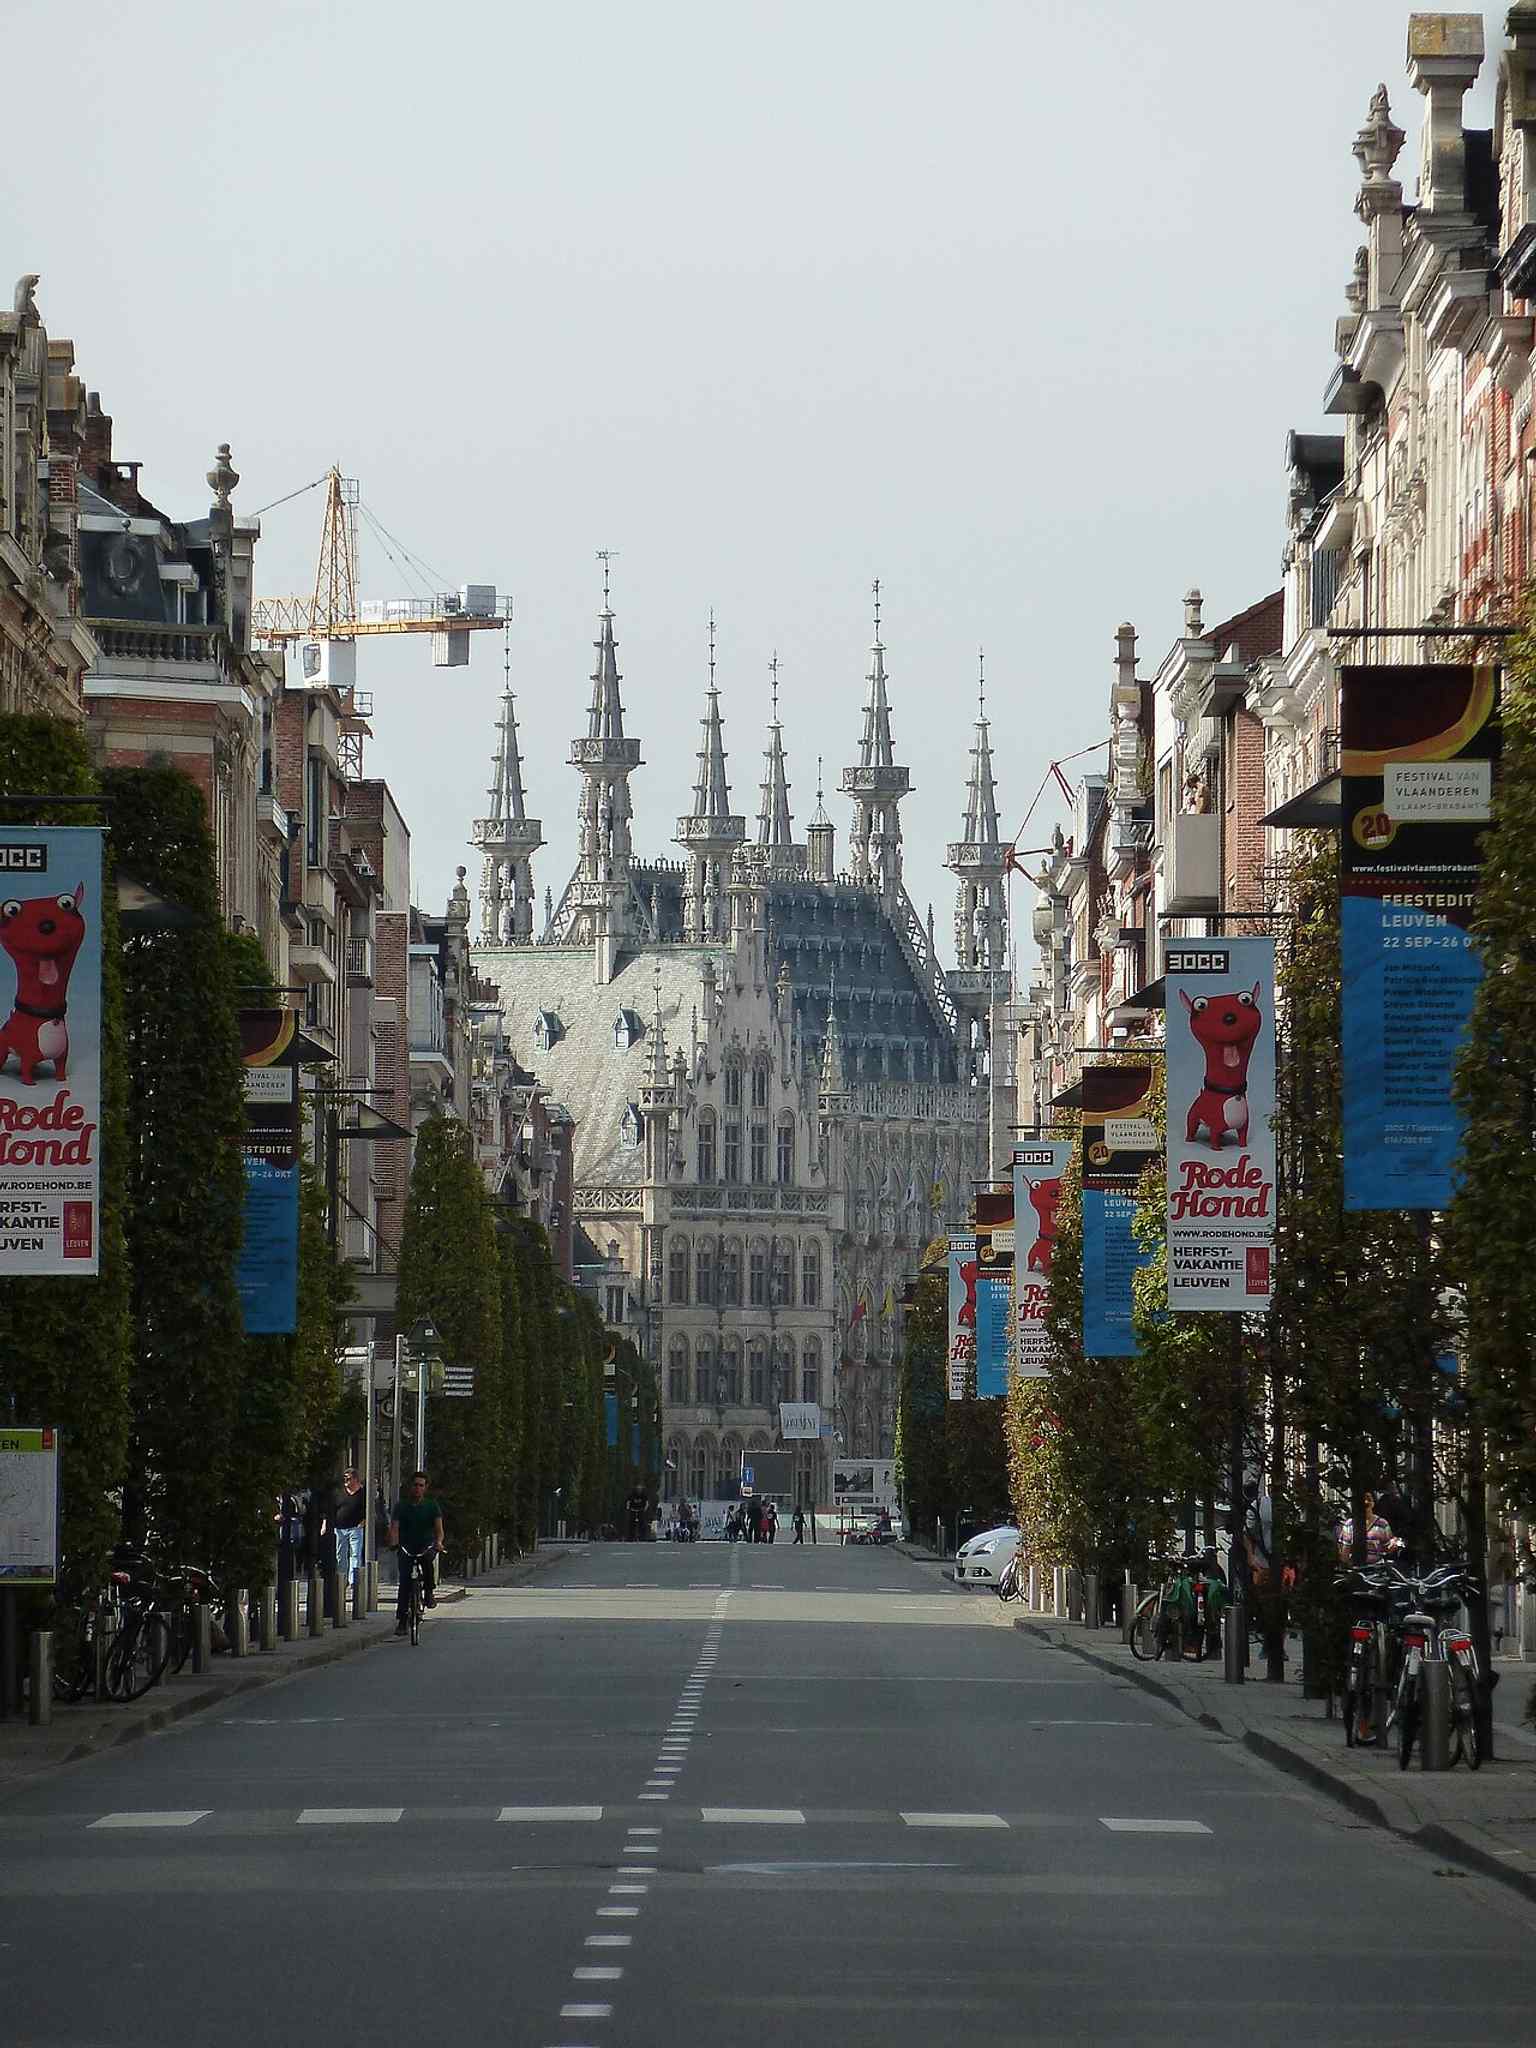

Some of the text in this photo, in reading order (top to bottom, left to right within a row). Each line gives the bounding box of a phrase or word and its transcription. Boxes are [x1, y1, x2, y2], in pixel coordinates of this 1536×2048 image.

[1396, 772, 1479, 782] FESTIVAL VAN
[1396, 787, 1479, 797] VLAANDEREN
[1360, 813, 1392, 838] 20
[1382, 914, 1447, 928] LEUVEN
[1383, 937, 1400, 948] 22
[1169, 954, 1225, 970] 30CC
[1015, 1152, 1052, 1163] 30CC
[1092, 1145, 1109, 1159] 20
[1179, 1154, 1263, 1191] Rode
[1170, 1183, 1273, 1221] Hond
[1173, 1247, 1233, 1257] HERFST-
[1173, 1259, 1244, 1270] VAKANTIE
[1173, 1277, 1230, 1288] LEUVEN
